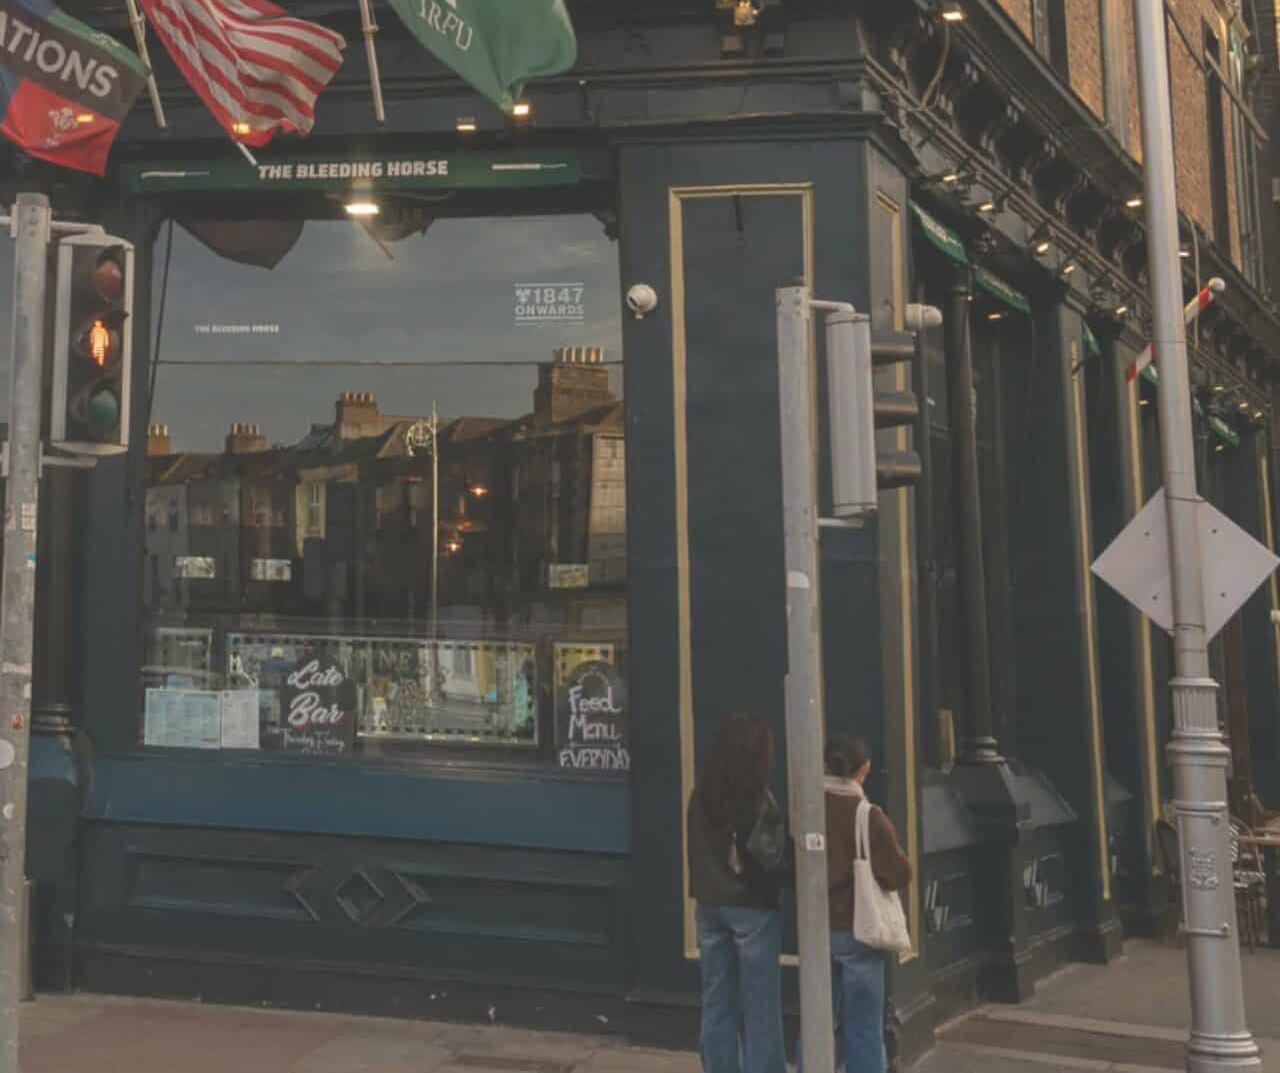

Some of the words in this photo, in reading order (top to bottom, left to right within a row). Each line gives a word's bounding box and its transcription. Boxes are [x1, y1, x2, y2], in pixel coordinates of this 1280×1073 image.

[258, 165, 293, 179] THE
[296, 162, 383, 178] BLEEDING
[387, 160, 449, 175] HORSE
[534, 287, 584, 304] 1847
[515, 303, 584, 315] ONWARDS
[288, 659, 344, 689] Late
[287, 692, 345, 726] Bar
